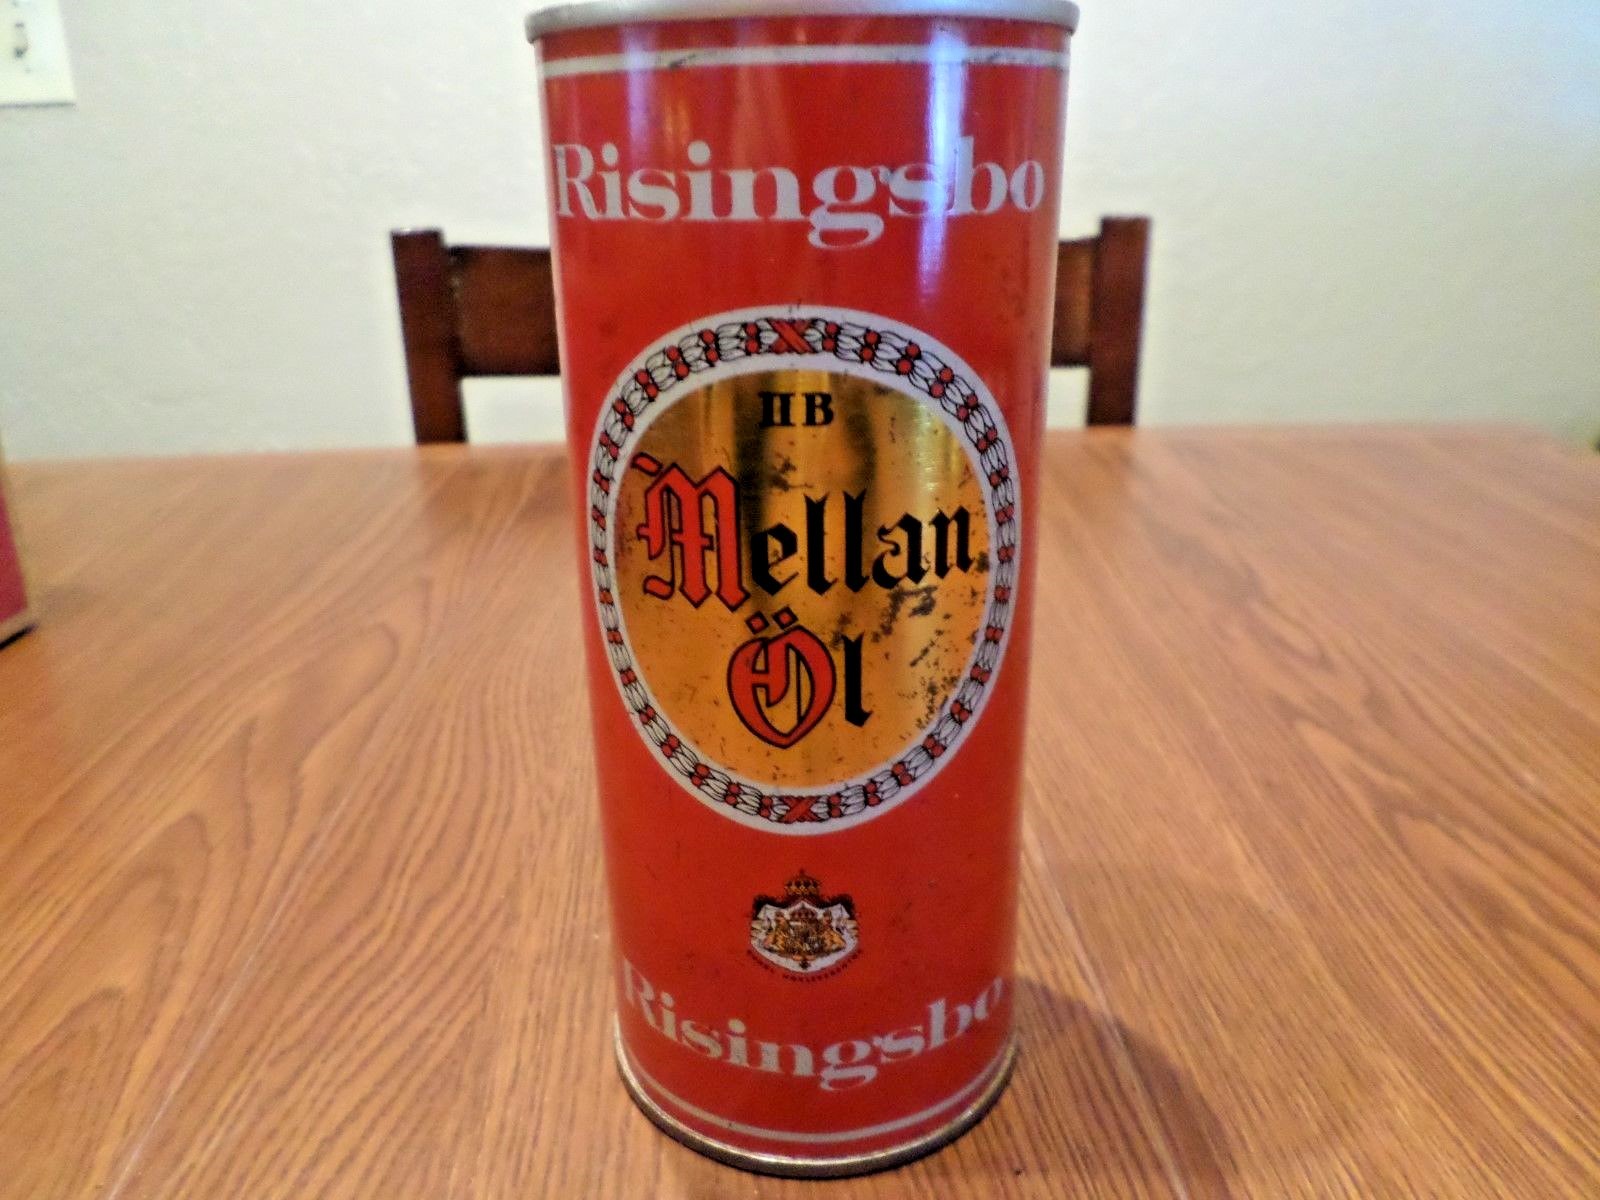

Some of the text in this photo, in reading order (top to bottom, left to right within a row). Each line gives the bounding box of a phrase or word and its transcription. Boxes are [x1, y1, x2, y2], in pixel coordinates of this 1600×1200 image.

[552, 136, 1044, 250] Risingsbo
[631, 452, 974, 612] Mellan
[726, 606, 873, 749] Öl
[622, 955, 1003, 1092] Risingsbo
